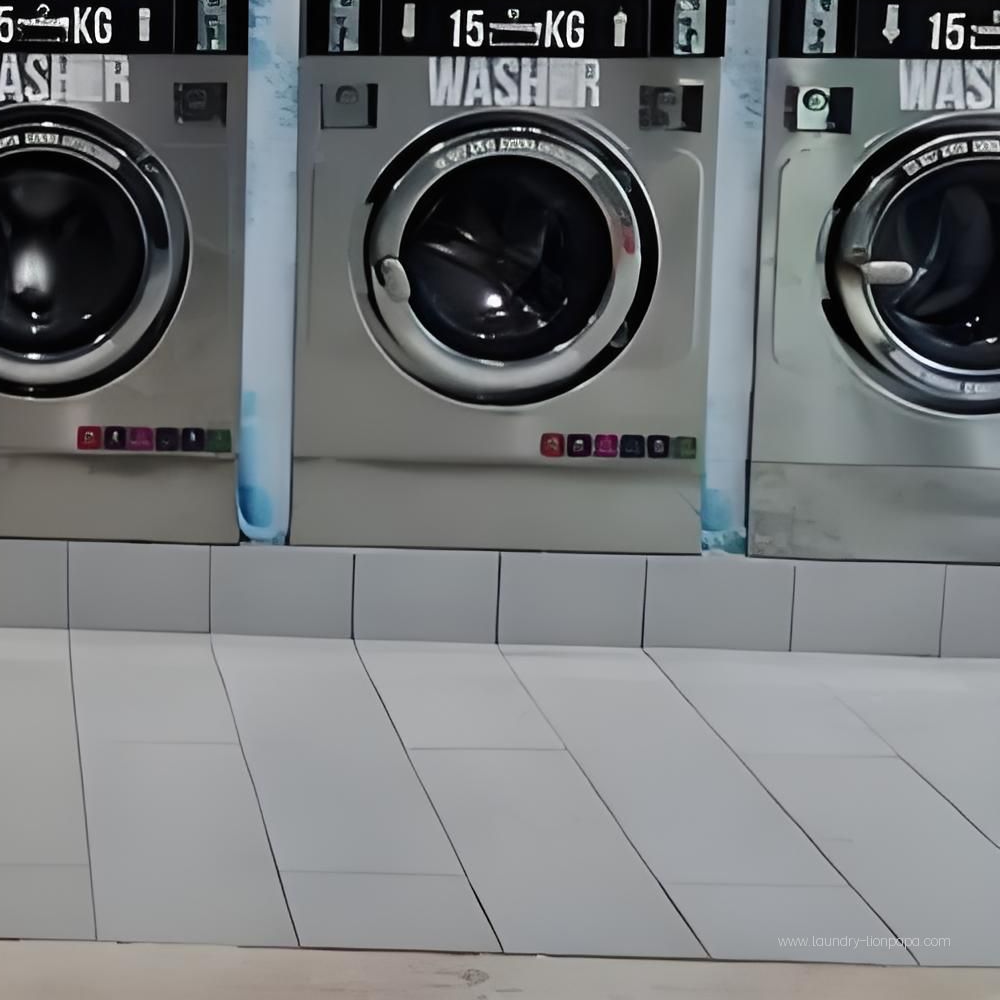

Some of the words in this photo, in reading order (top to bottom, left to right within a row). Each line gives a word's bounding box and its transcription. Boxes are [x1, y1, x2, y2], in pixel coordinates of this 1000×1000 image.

[73, 6, 113, 45] KG
[450, 9, 486, 48] 15
[544, 9, 586, 49] KG
[928, 12, 967, 51] 15
[428, 56, 600, 108] WASHR
